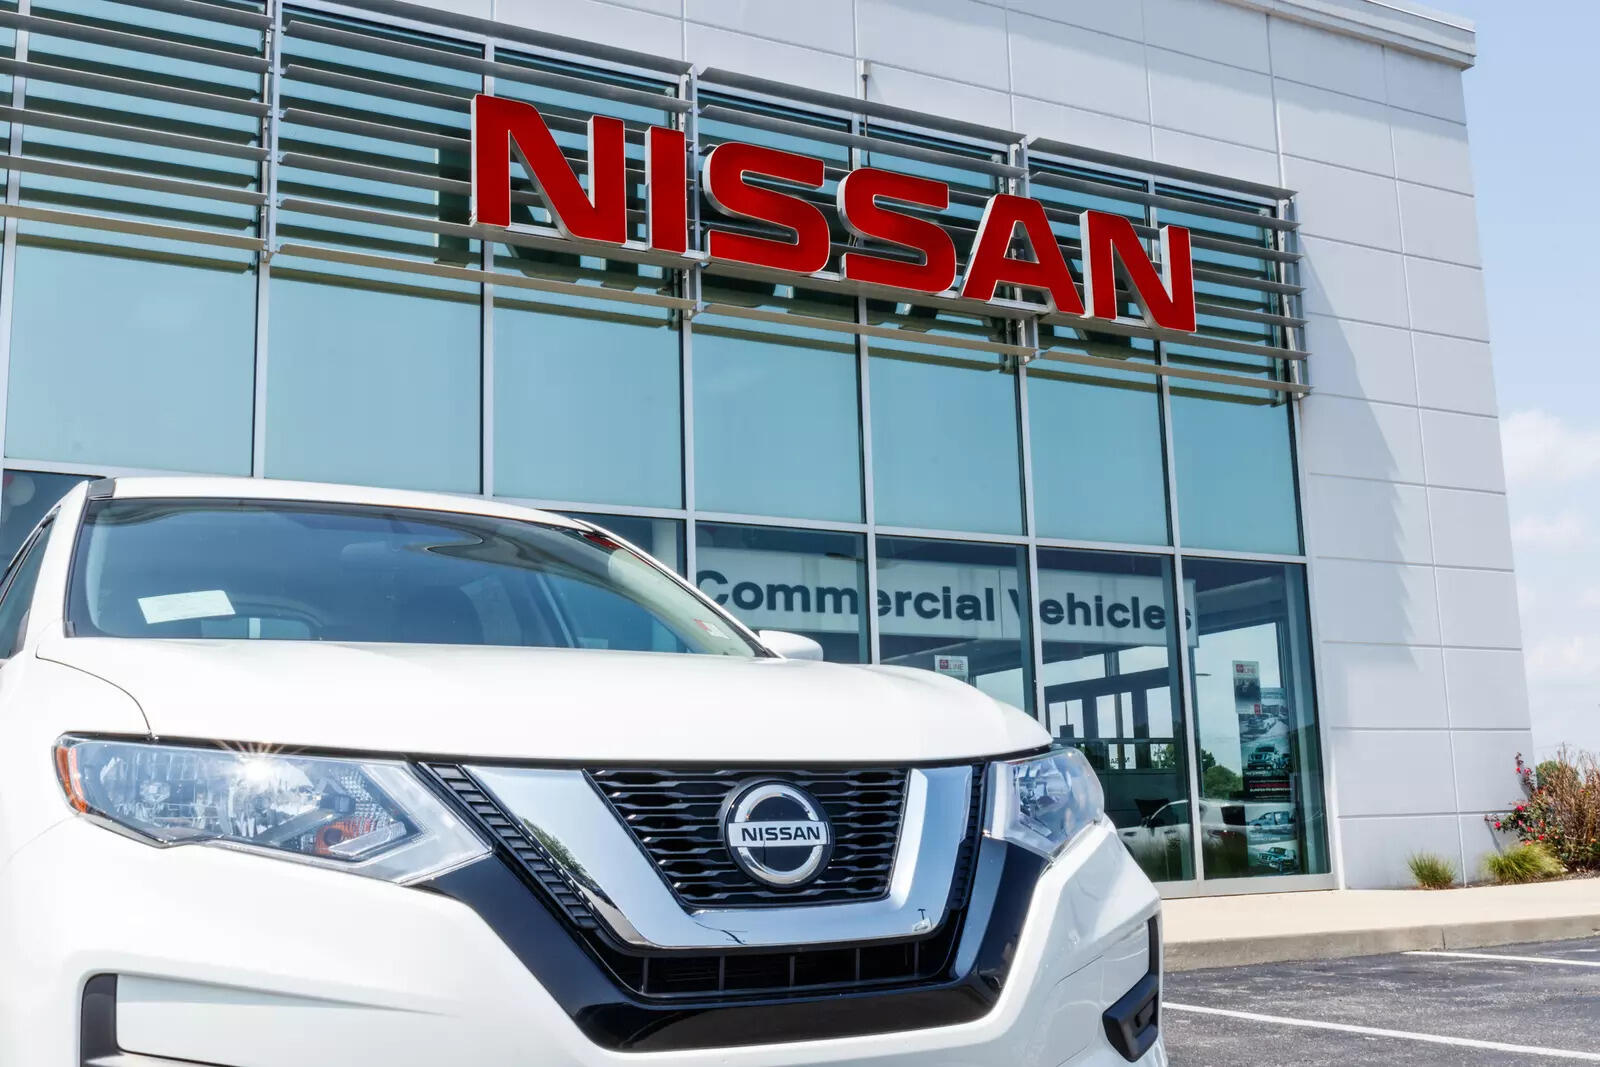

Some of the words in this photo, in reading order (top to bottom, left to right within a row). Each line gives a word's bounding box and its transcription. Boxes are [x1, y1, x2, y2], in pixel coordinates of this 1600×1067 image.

[470, 94, 1196, 333] NISSAN
[696, 570, 995, 621] Commercial
[741, 826, 820, 841] NISSAN
